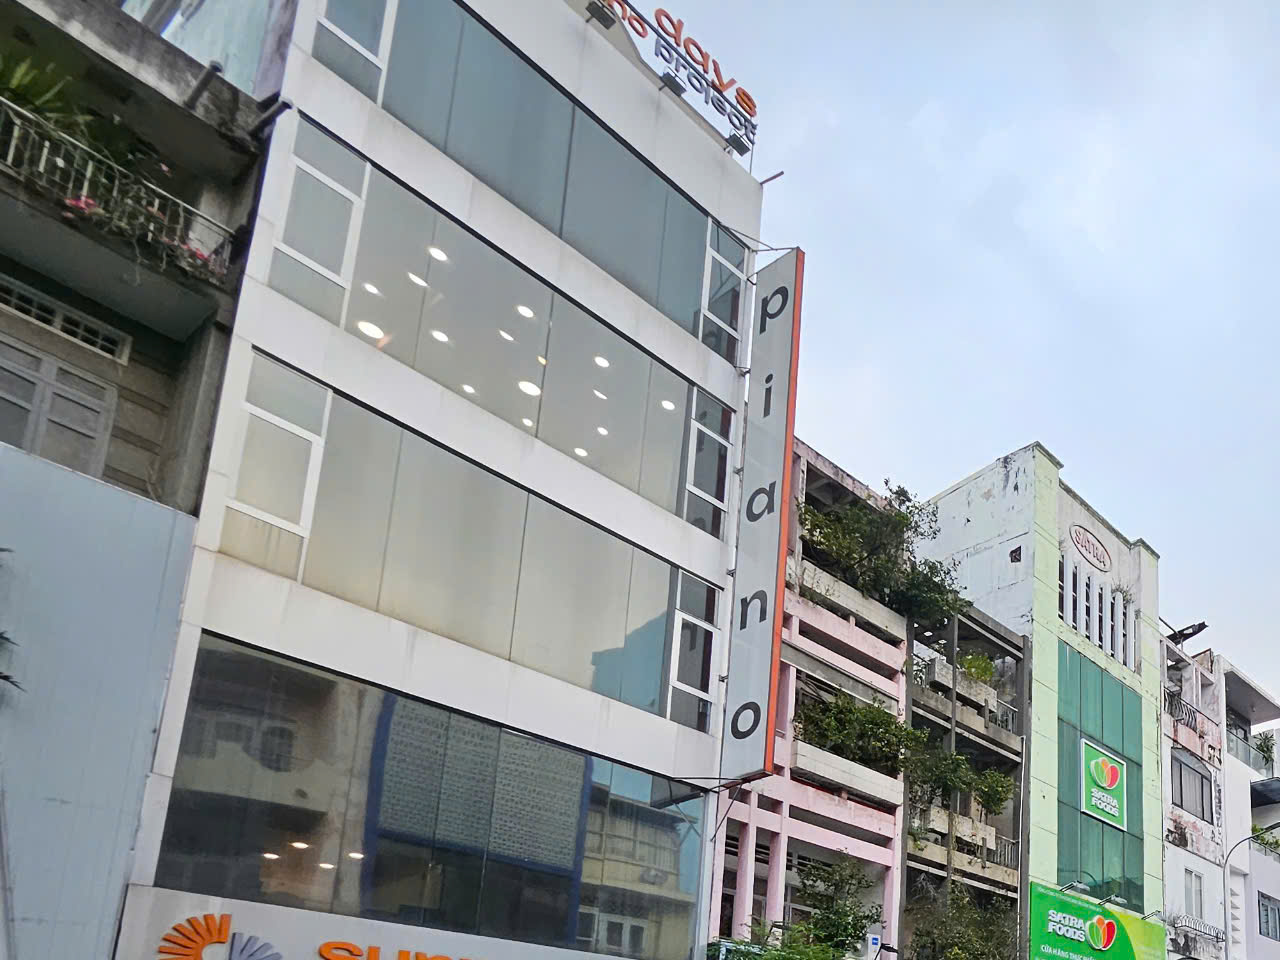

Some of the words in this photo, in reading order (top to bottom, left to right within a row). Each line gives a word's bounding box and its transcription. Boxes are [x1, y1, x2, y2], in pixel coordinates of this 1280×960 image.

[730, 285, 789, 741] piano
[1073, 528, 1107, 567] SATRA
[1090, 787, 1119, 809] SATRA
[1091, 796, 1120, 817] FOODS
[1047, 909, 1085, 929] SATRA
[1047, 921, 1086, 942] FOODS
